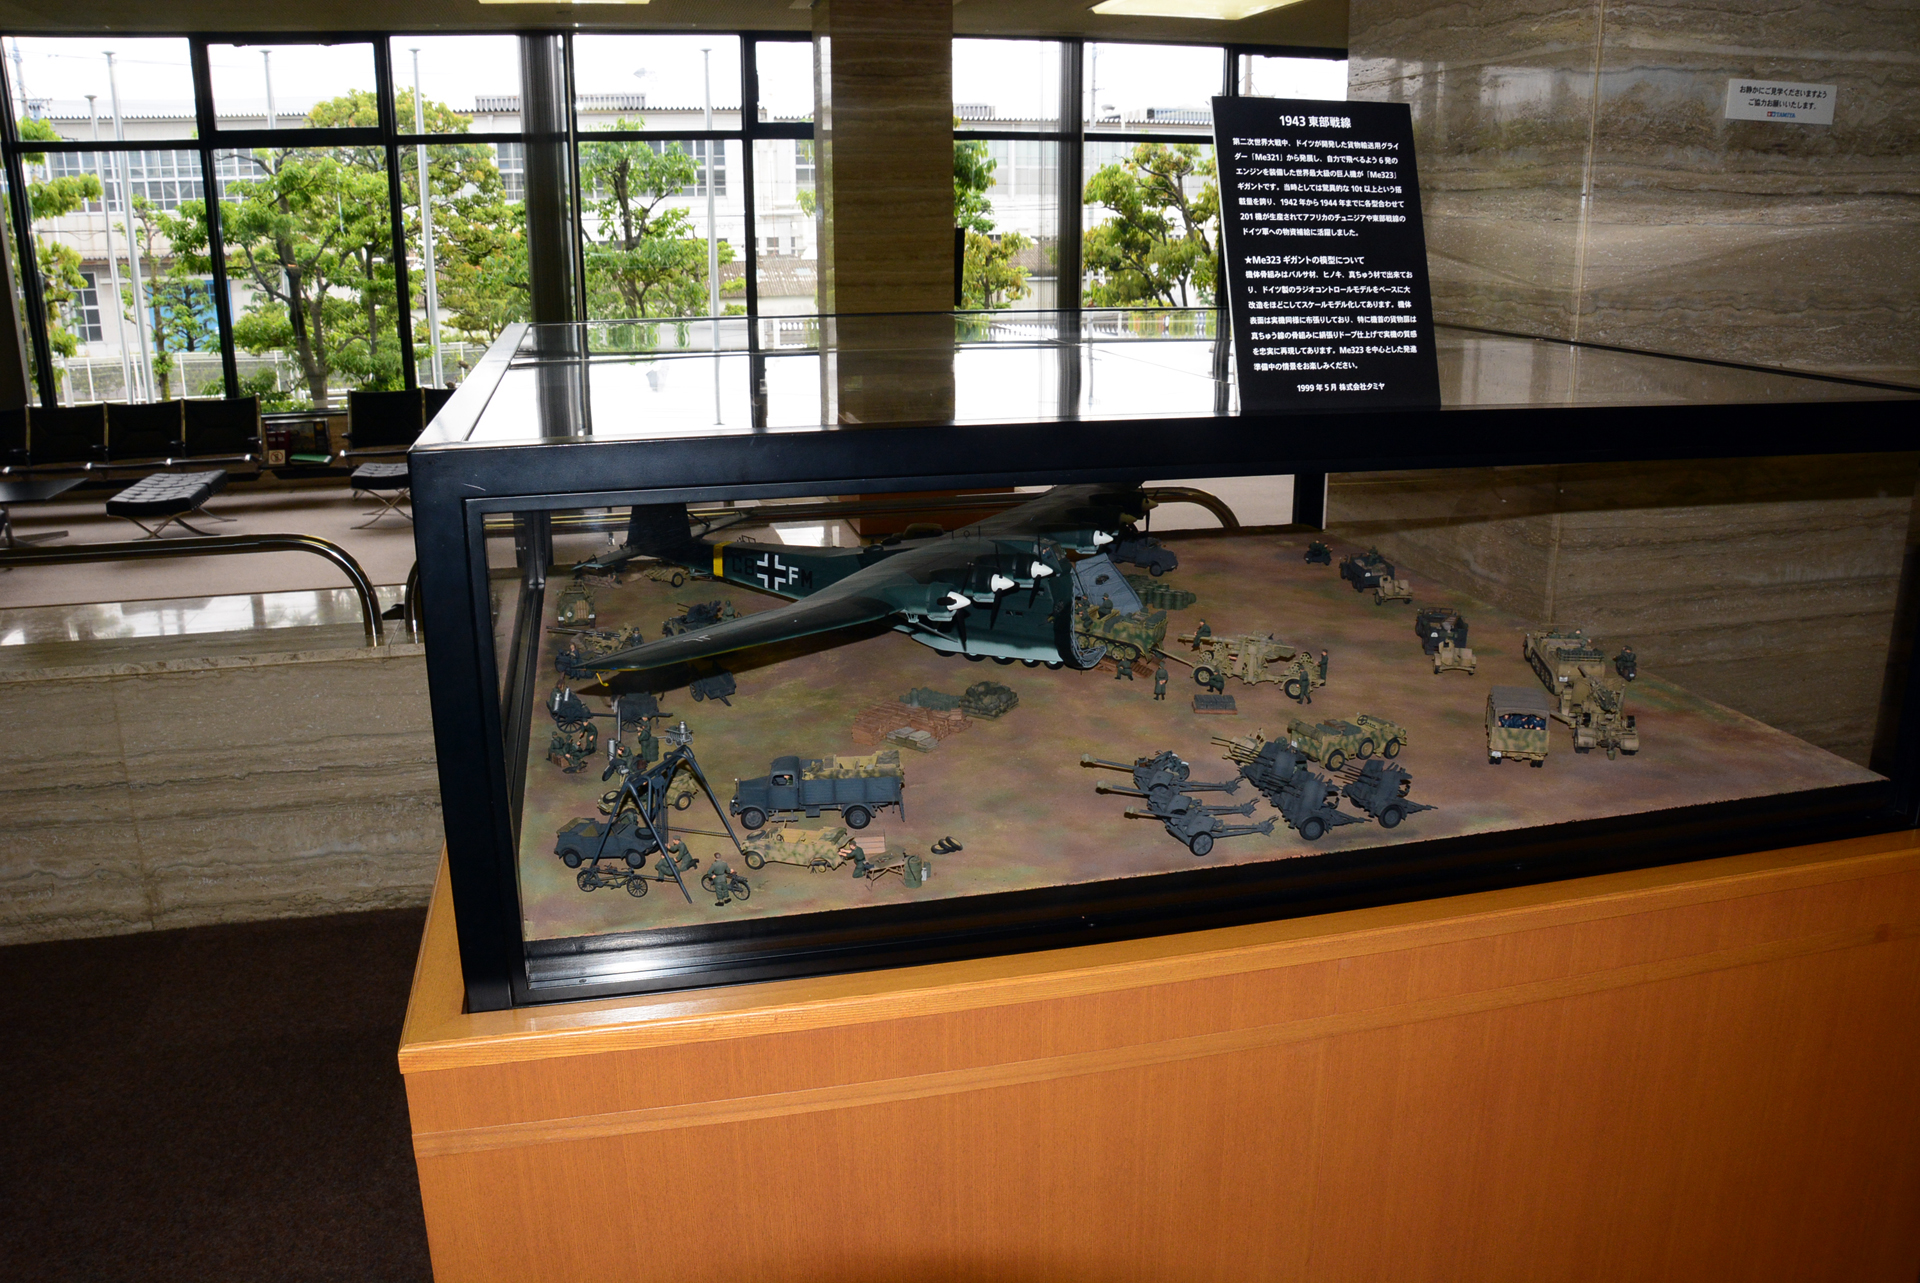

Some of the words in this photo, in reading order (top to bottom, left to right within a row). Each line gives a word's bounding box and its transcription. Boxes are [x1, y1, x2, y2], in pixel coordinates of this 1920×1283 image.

[1739, 85, 1828, 99] お静かにご見学くださいますよう
[1748, 98, 1817, 110] ご協力お願いいたします。
[1279, 115, 1306, 127] 1943
[1308, 116, 1352, 129] 東部戦線
